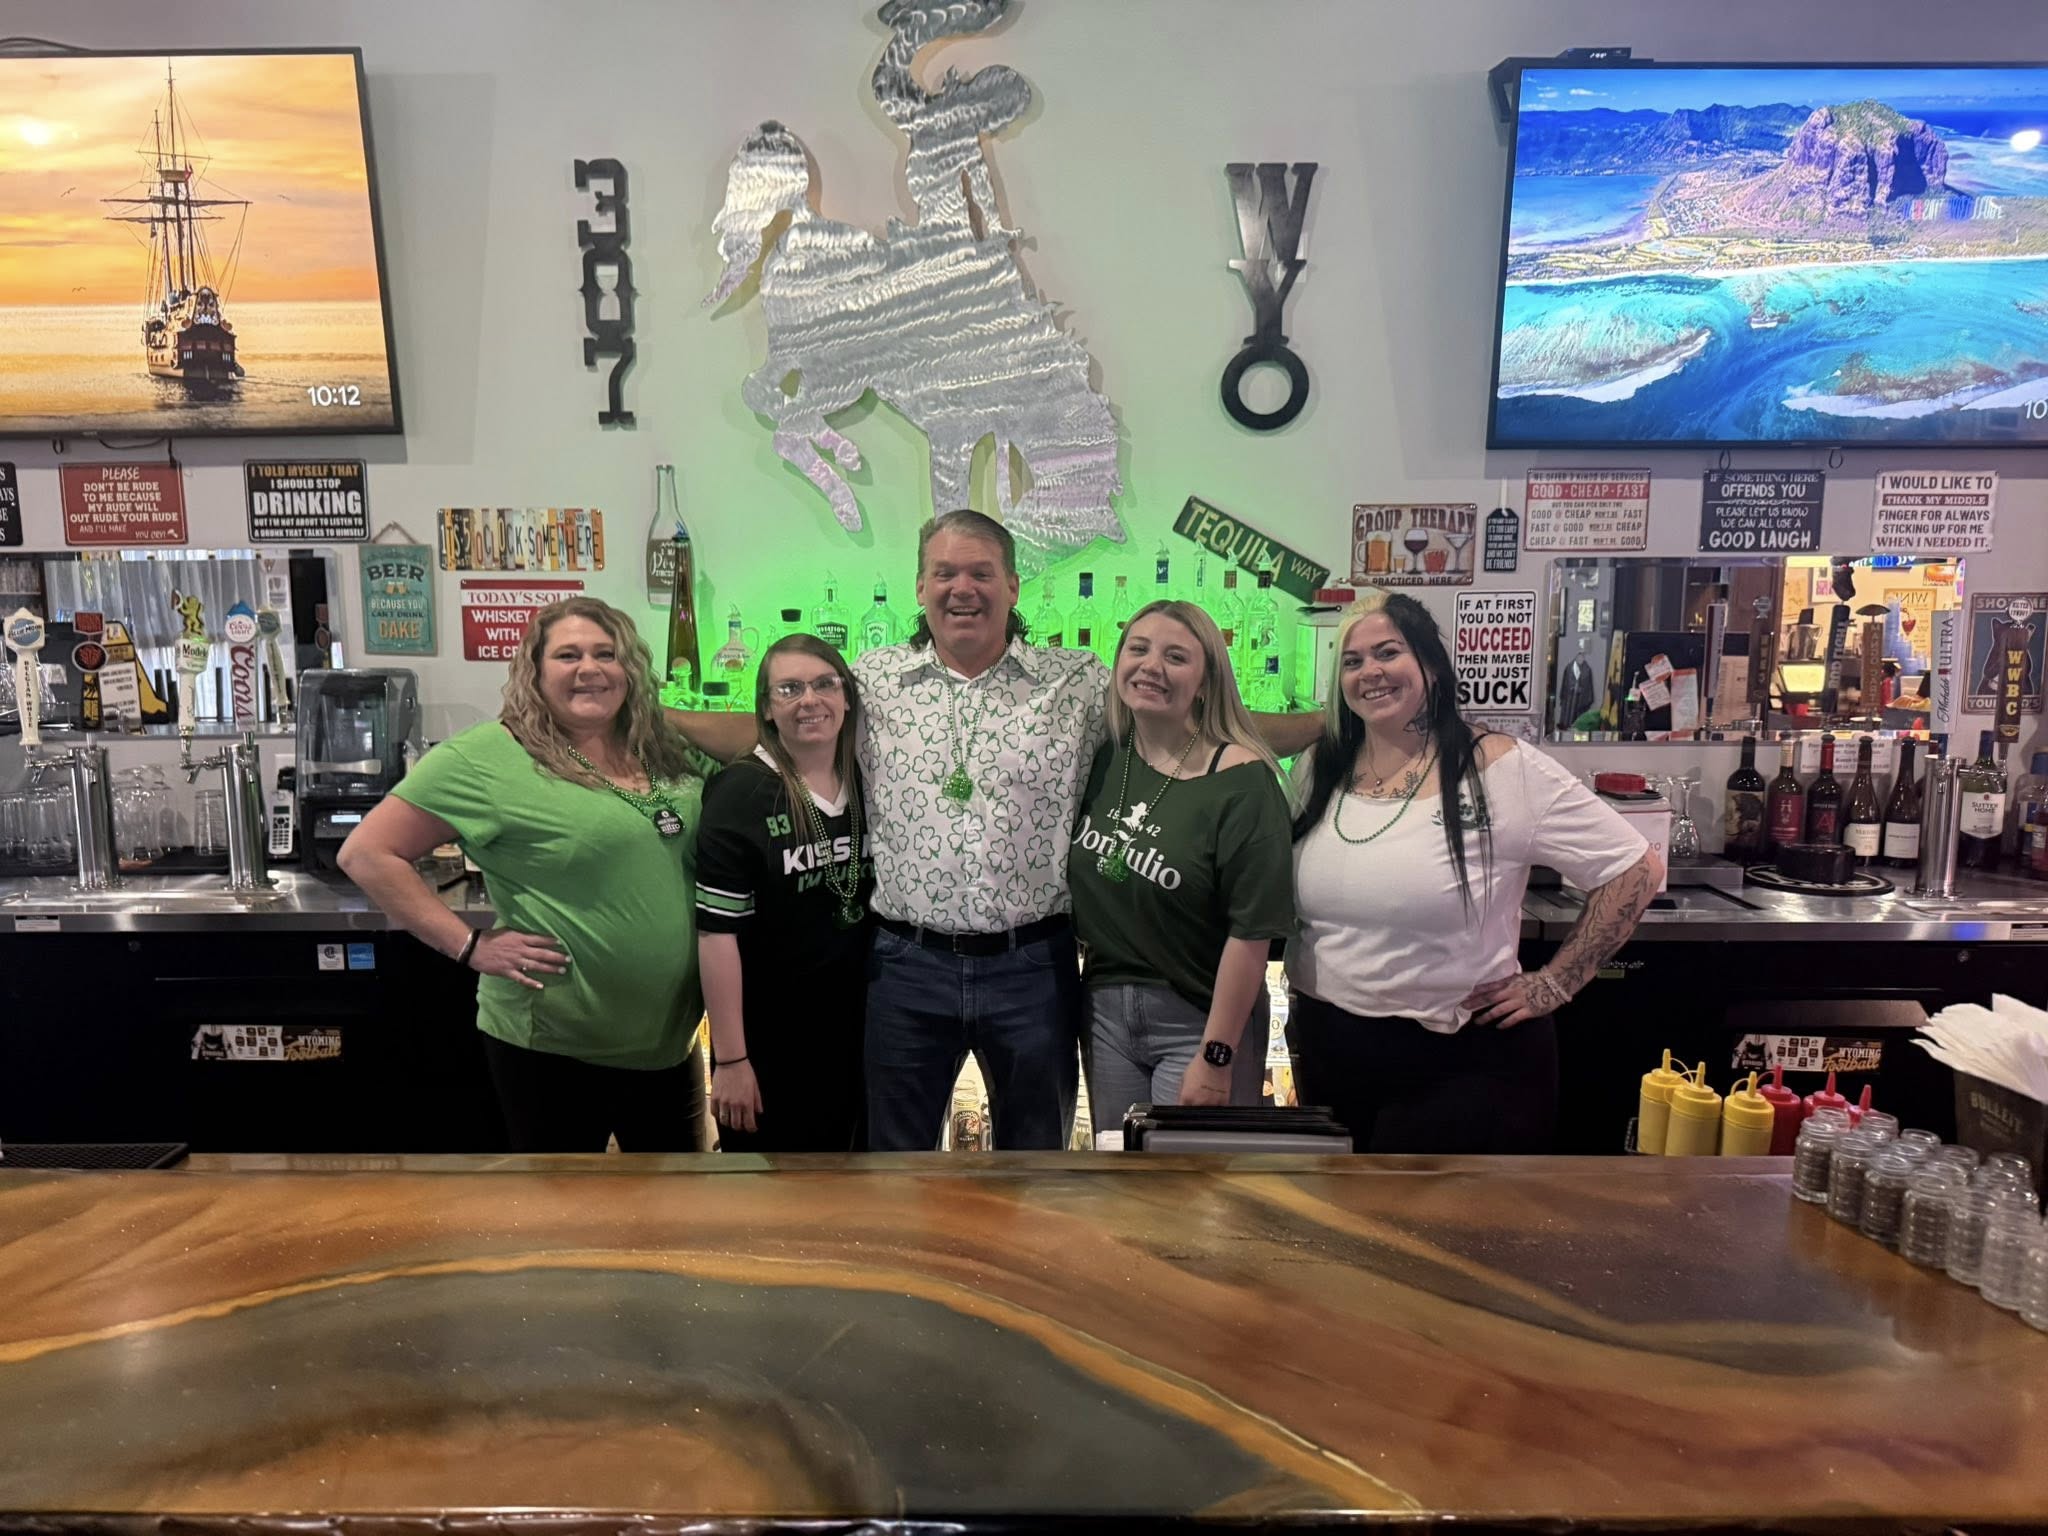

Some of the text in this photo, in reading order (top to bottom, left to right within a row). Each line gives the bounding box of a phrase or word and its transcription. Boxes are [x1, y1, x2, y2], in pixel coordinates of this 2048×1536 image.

[1221, 162, 1318, 430] WYO
[307, 385, 361, 406] 10:12
[102, 467, 139, 480] PLEASE
[258, 465, 285, 477] TOLD
[287, 464, 329, 476] MYSELF
[332, 464, 359, 476] THAT
[1576, 472, 1598, 480] KINDS
[1601, 472, 1609, 480] OF
[1611, 472, 1643, 480] SERVICES
[276, 479, 314, 489] SHOULD
[316, 478, 341, 489] STOP
[1710, 473, 1818, 482] IF SOMETHING HERE
[1881, 476, 1993, 489] I WOULD LIKE TO
[84, 482, 159, 492] DON'T BE RUDE
[1532, 484, 1645, 498] GOOD CHEAP FAST
[1721, 484, 1806, 497] OFFENDS YOU
[83, 492, 161, 502] TO ME BECAUSE
[253, 490, 362, 516] DRINKING
[1886, 495, 1985, 505] THANK MY MIDDLE
[88, 502, 158, 512] MY RUDE WILL
[1716, 507, 1808, 517] PLEASE LET US KNOW
[70, 512, 178, 523] OUT RUDE YOUR RUDE
[1531, 510, 1643, 519] GOOD CHEAP FAST
[1878, 510, 1990, 520] FINGER FOR ALWAYS
[296, 518, 319, 526] ABOUT
[330, 518, 352, 526] LISTEN
[354, 517, 363, 525] TO
[1355, 508, 1476, 541] GROUP THERAPY
[1530, 522, 1642, 532] FAST GOOD CHEAP
[1721, 518, 1801, 528] WE CAN ALL USE A
[80, 525, 93, 534] AND
[109, 524, 127, 533] MAKE
[285, 528, 302, 537] THAT
[304, 528, 325, 537] TALKS
[326, 528, 335, 537] TO
[336, 528, 364, 537] HIMSELF
[1882, 524, 1984, 534] STICKING UP FOR ME
[1184, 502, 1320, 584] TEQUILA WAY
[1530, 536, 1641, 546] CHEAP FAST GOOD
[1709, 530, 1811, 549] GOOD LAUGH
[1876, 537, 1989, 548] WHEN I NEEDED IT.
[367, 563, 424, 582] BEER
[1372, 577, 1452, 585] PRACTICED HERE
[371, 599, 406, 609] BECAUSE
[468, 592, 533, 604] TODAY'S
[1460, 599, 1533, 610] IF AT FIRST
[471, 610, 531, 623] WHISKEY
[1460, 613, 1532, 624] YOU DO NOT
[381, 620, 420, 639] CAKE
[485, 628, 520, 640] WITH
[1458, 627, 1531, 651] SUCCEED
[1940, 617, 1953, 667] ULTRA
[478, 646, 499, 658] ICE
[1457, 654, 1530, 664] THEN MAYBE
[1457, 667, 1529, 679] YOU JUST
[231, 645, 255, 719] Coors
[1457, 681, 1528, 705] SUCK
[1936, 677, 1950, 722] Michelob
[766, 814, 791, 837] 93
[1146, 824, 1162, 837] 42
[783, 836, 851, 875] KISS
[299, 1036, 342, 1047] WYOMING
[1838, 1047, 1882, 1059] WYOMING
[1824, 1054, 1880, 1072] Football
